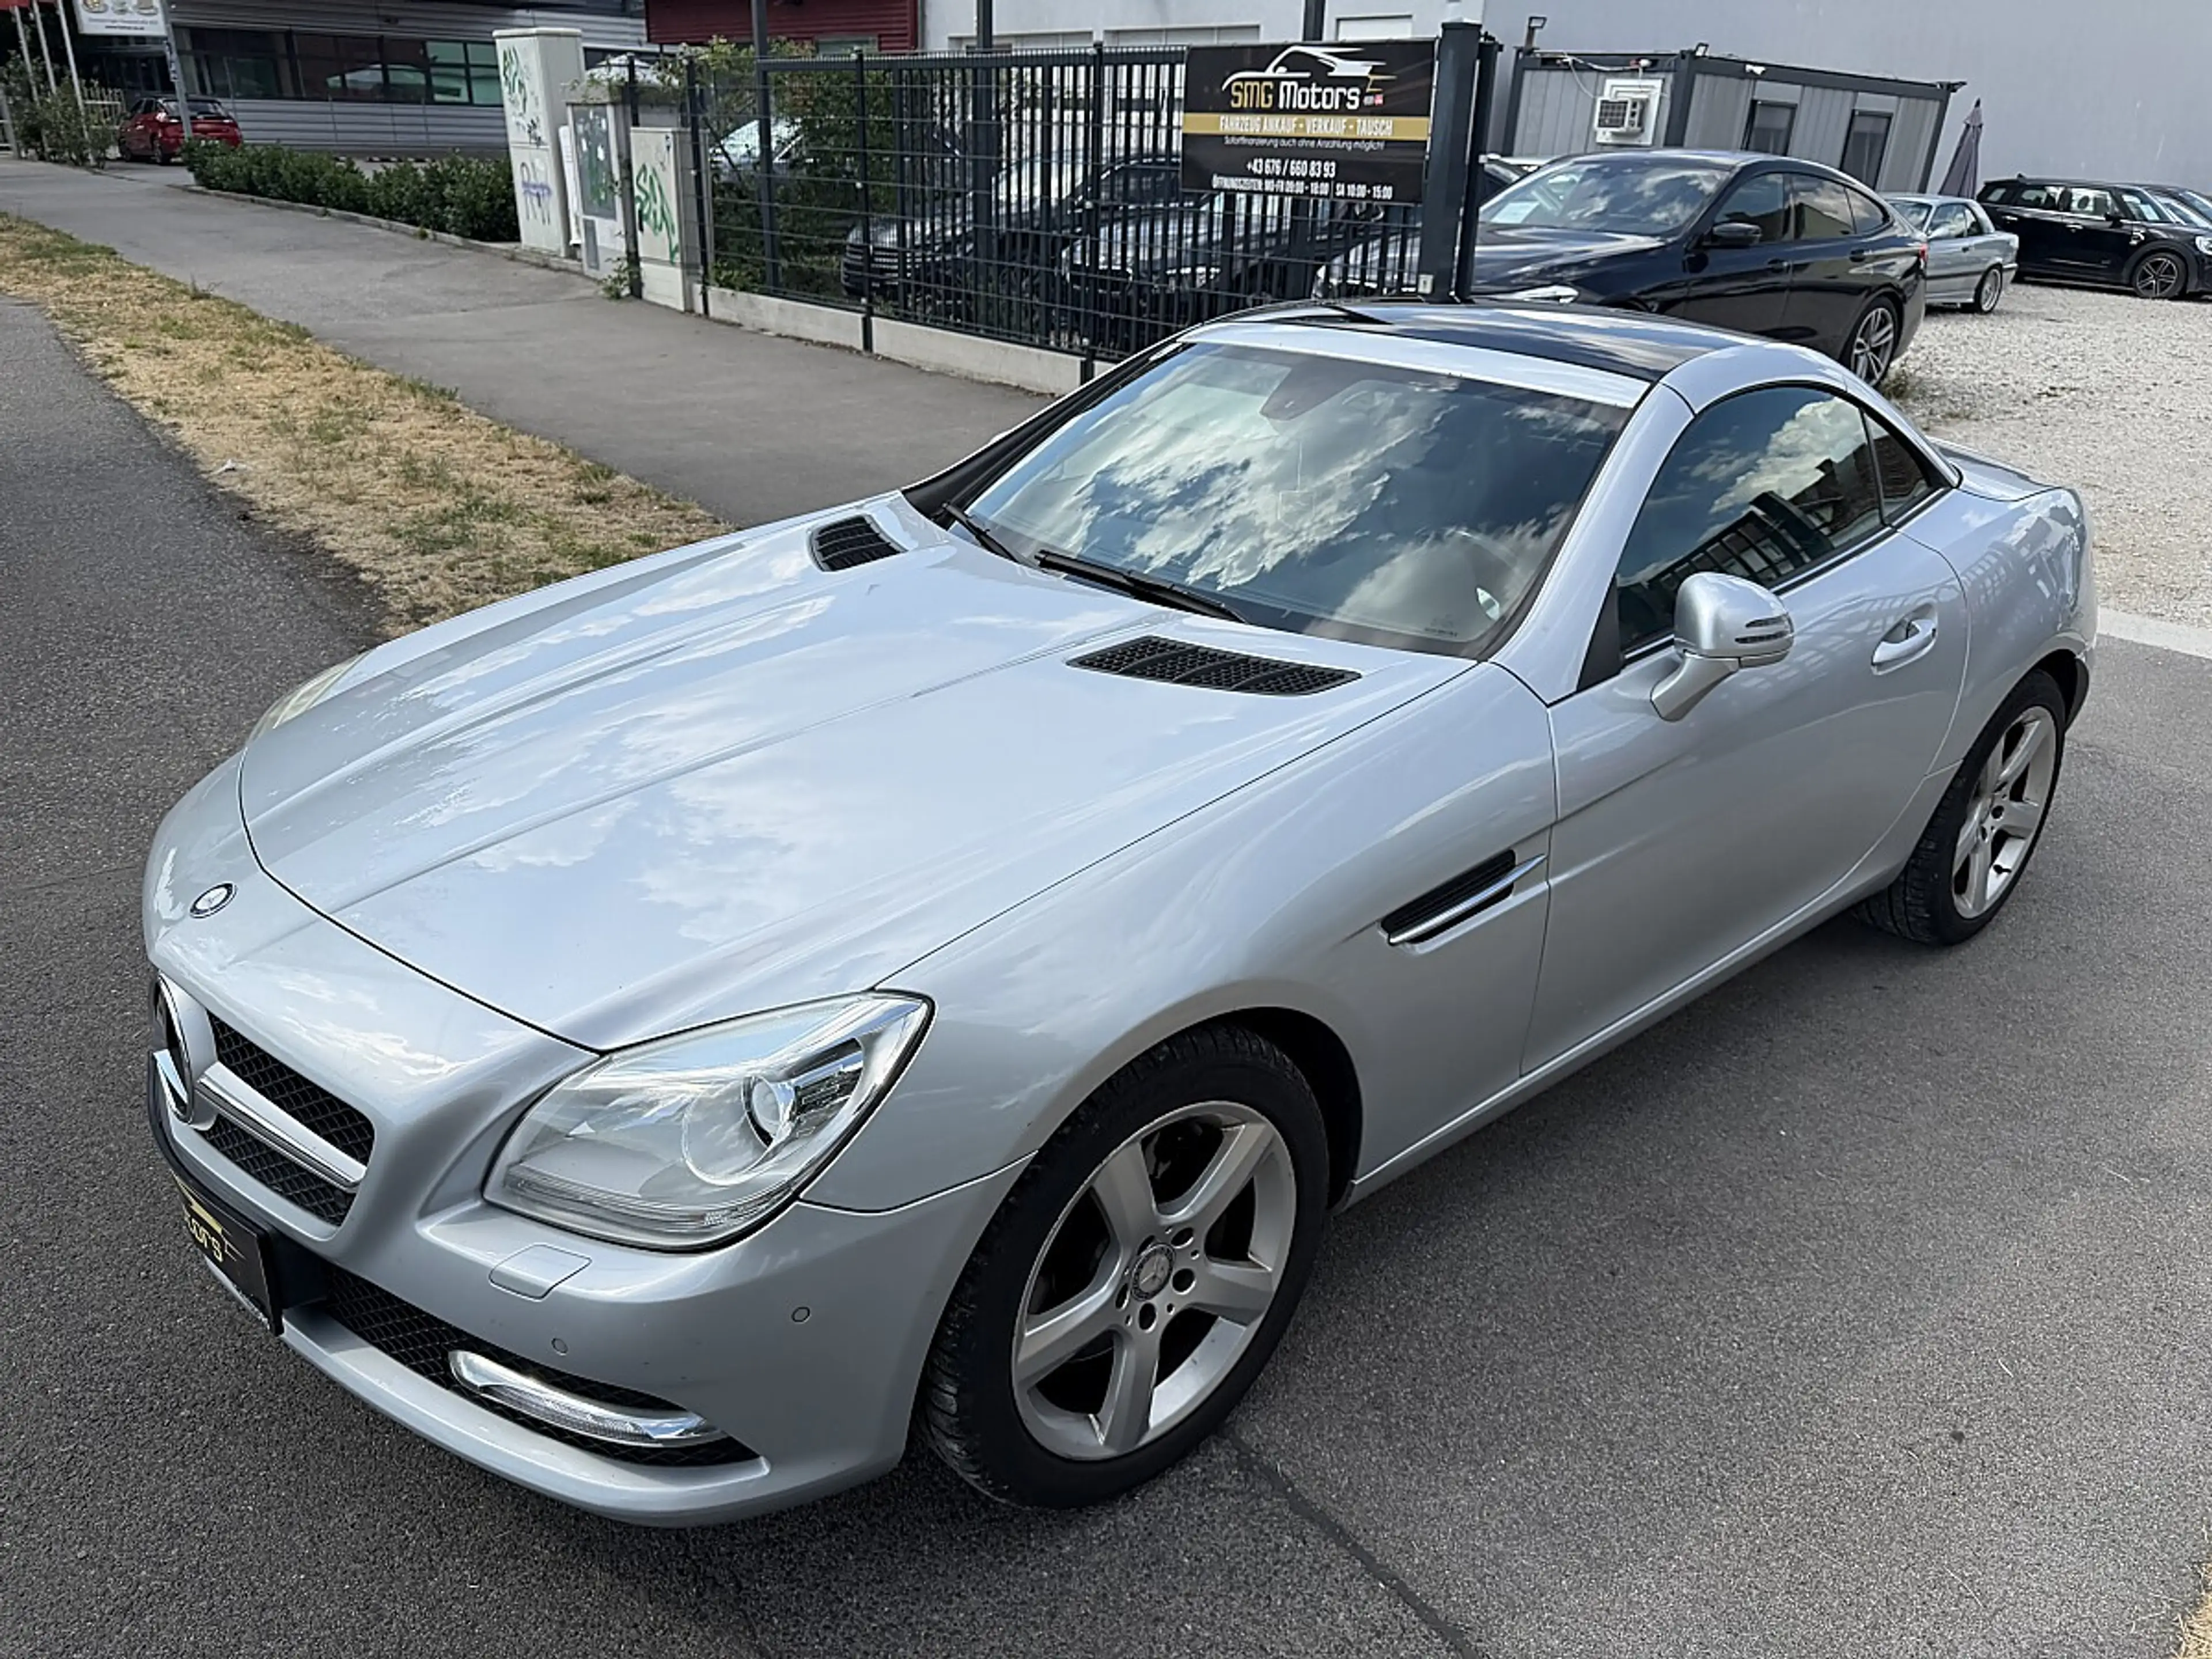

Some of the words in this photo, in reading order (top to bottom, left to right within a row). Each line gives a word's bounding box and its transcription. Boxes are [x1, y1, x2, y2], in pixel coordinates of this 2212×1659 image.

[1230, 81, 1274, 109] SMG
[1278, 81, 1361, 110] Motors
[1262, 117, 1297, 133] ANKAUF
[1305, 118, 1347, 135] VERKAUF
[1356, 119, 1393, 137] TAUSCH
[1309, 160, 1322, 178] 83
[1323, 161, 1336, 179] 93
